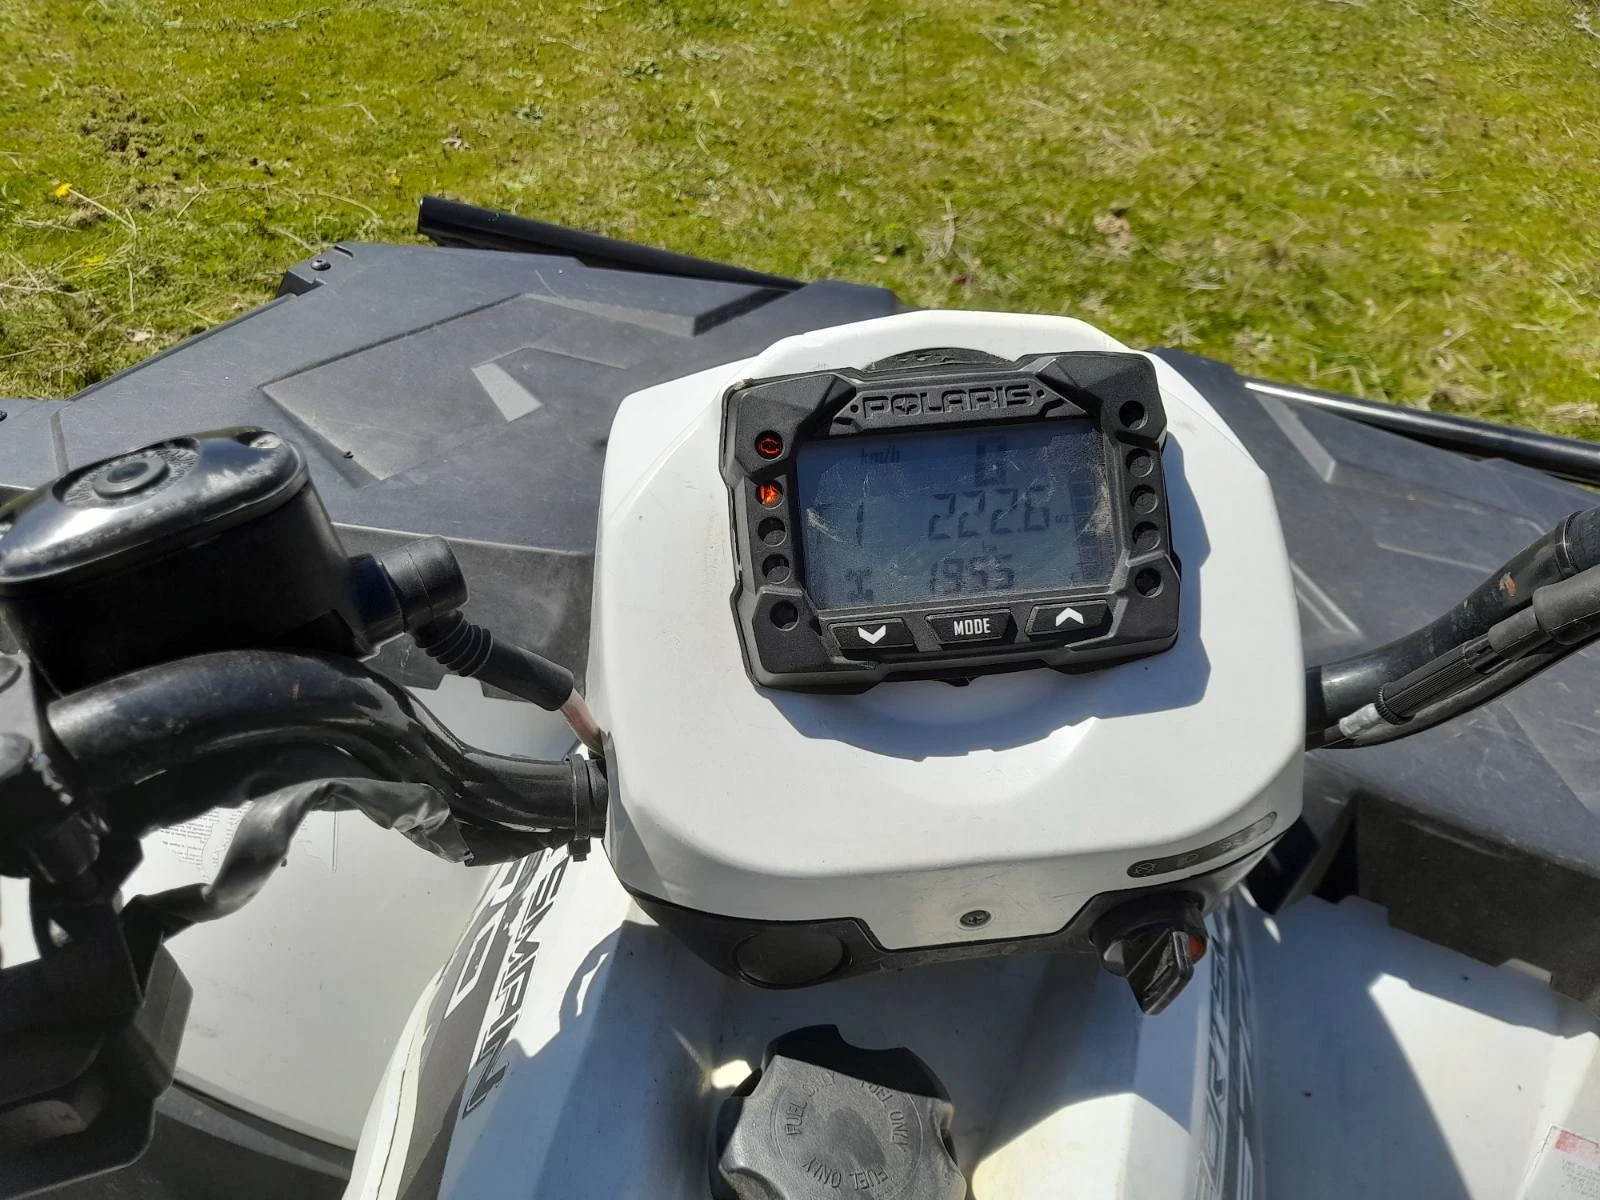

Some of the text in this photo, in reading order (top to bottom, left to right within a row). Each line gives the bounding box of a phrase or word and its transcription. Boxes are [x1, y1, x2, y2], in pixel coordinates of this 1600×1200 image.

[863, 384, 1034, 419] POLARIS
[861, 446, 902, 465] km/h
[953, 618, 991, 636] MODE
[784, 1101, 808, 1136] FUEL
[889, 1110, 910, 1153] ONLY
[801, 1155, 889, 1191] FUEL ONLY
